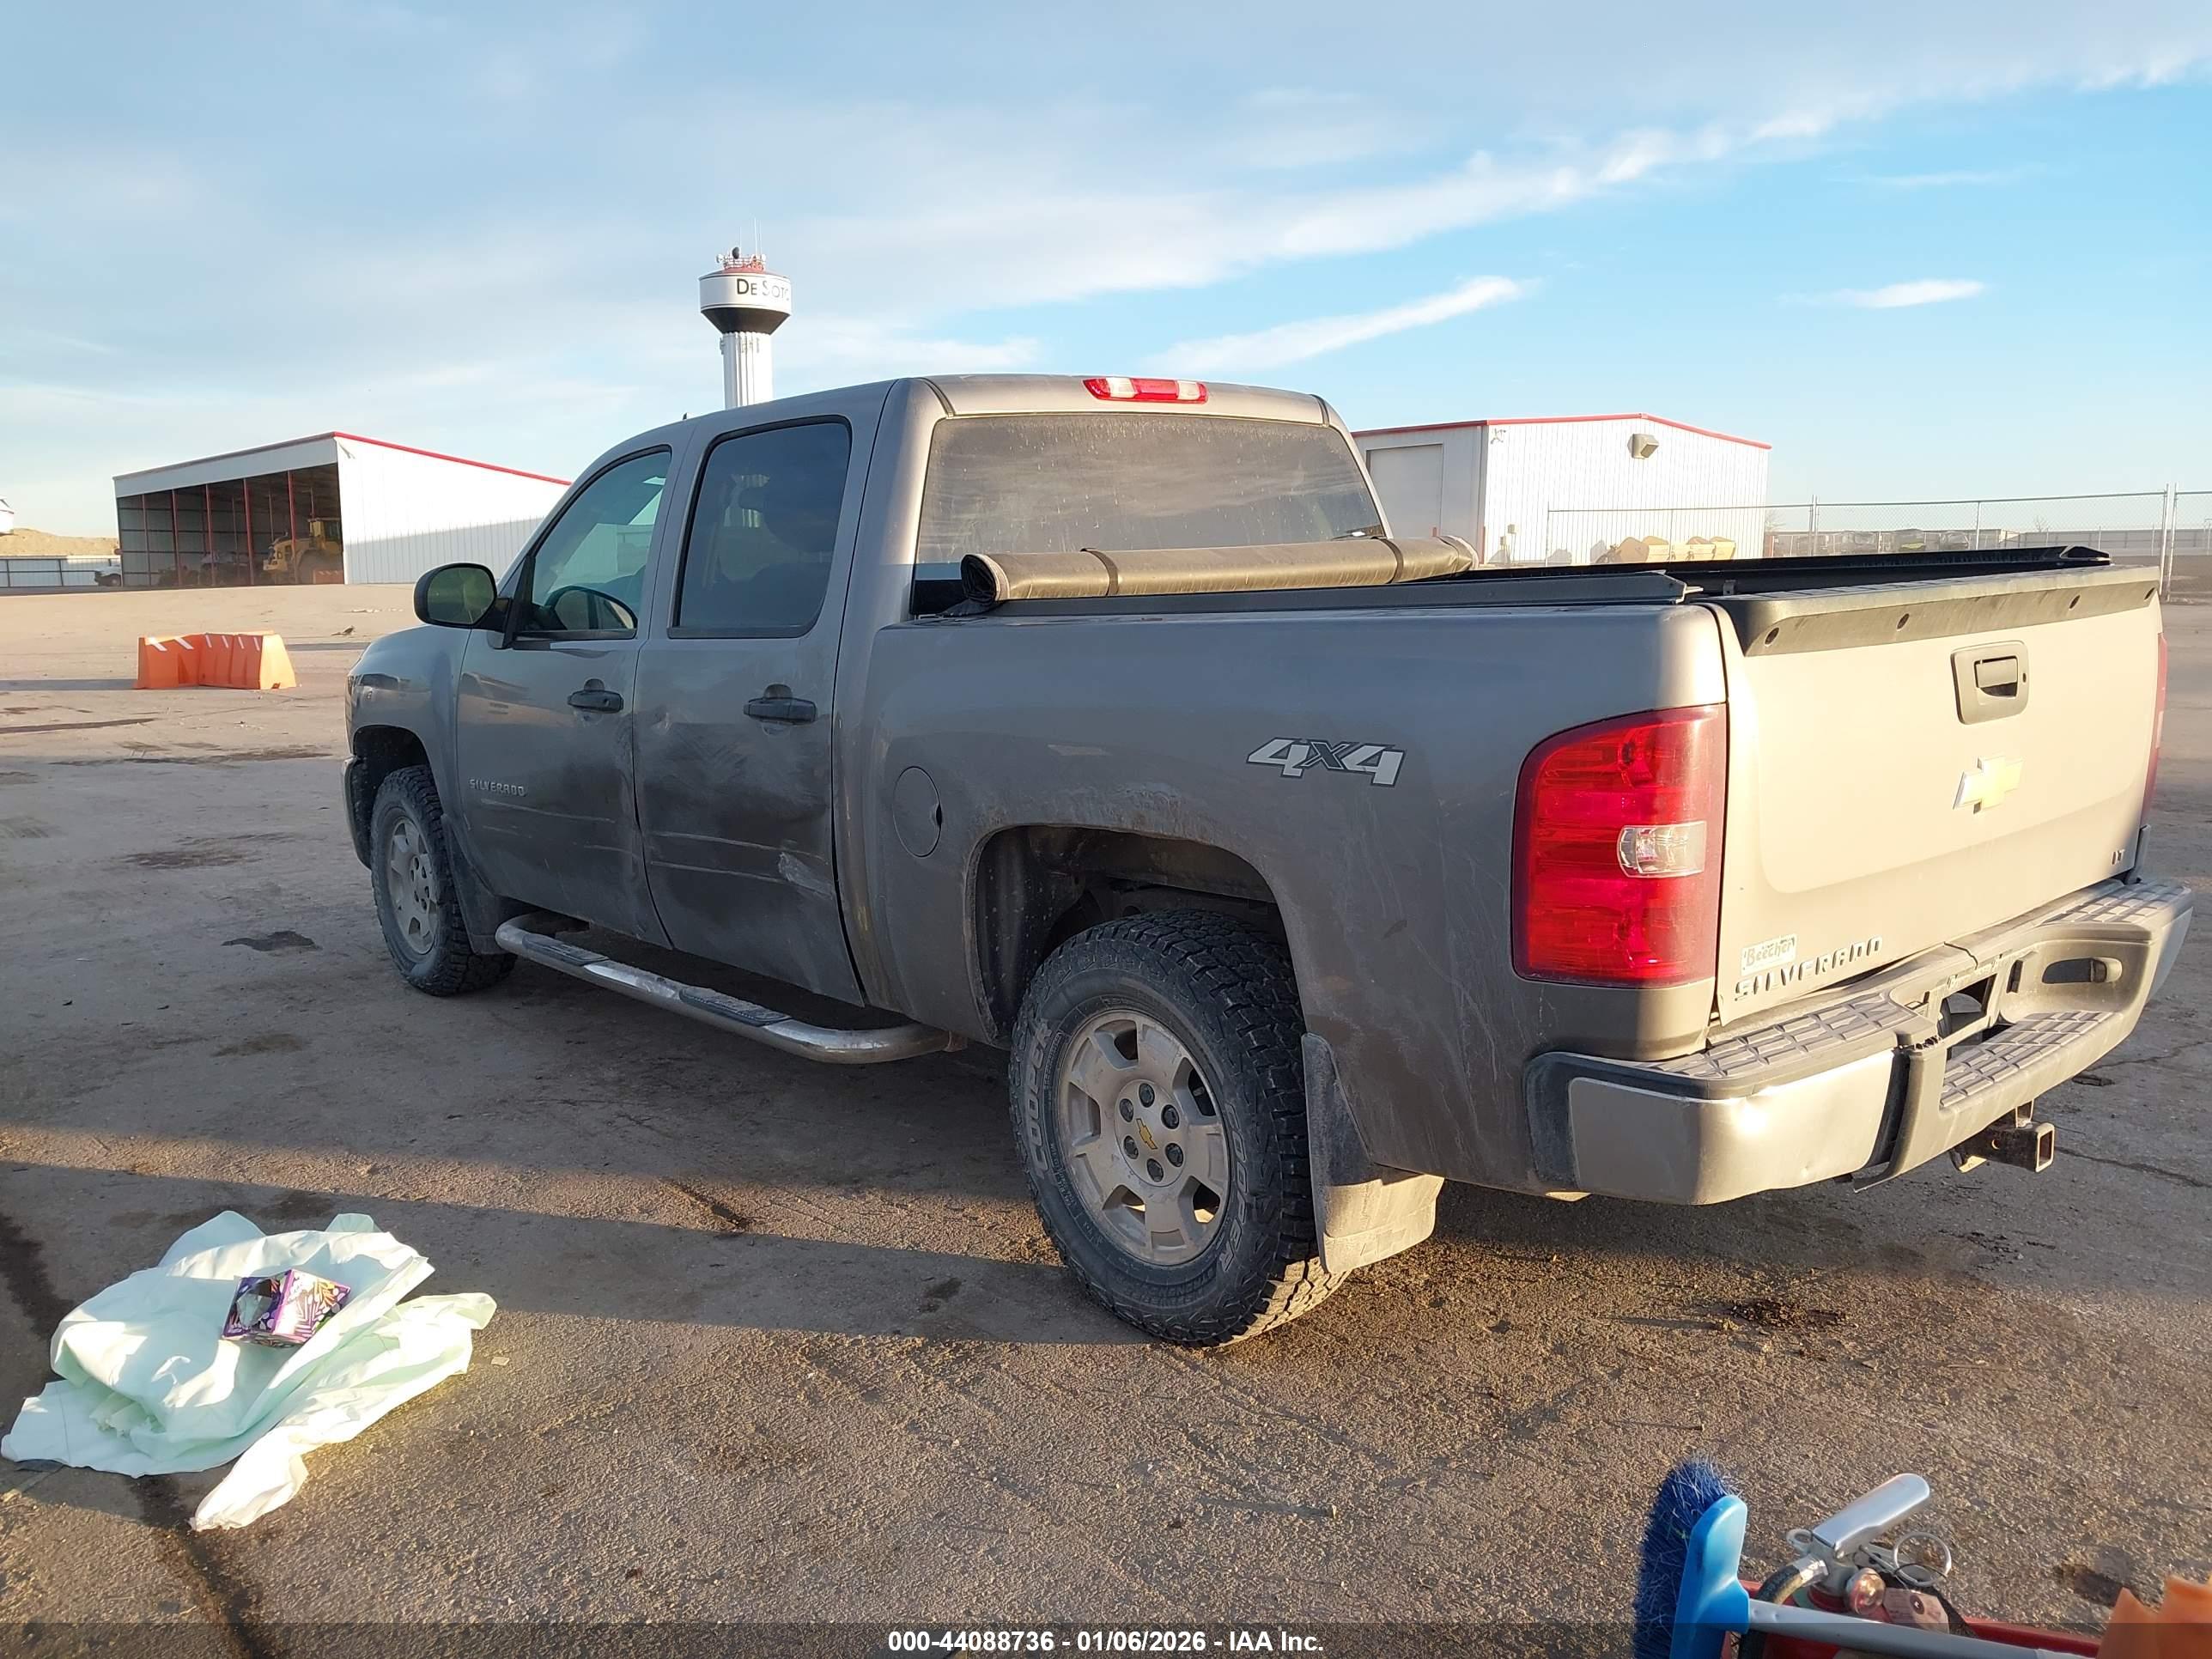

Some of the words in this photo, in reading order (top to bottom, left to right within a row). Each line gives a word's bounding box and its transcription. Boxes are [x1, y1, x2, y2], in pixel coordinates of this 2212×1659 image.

[469, 779, 526, 797] SILVERADO
[1735, 935, 1883, 996] SILVERADO
[1024, 1022, 1054, 1173] COOPER
[1223, 1102, 1251, 1273] COOPER
